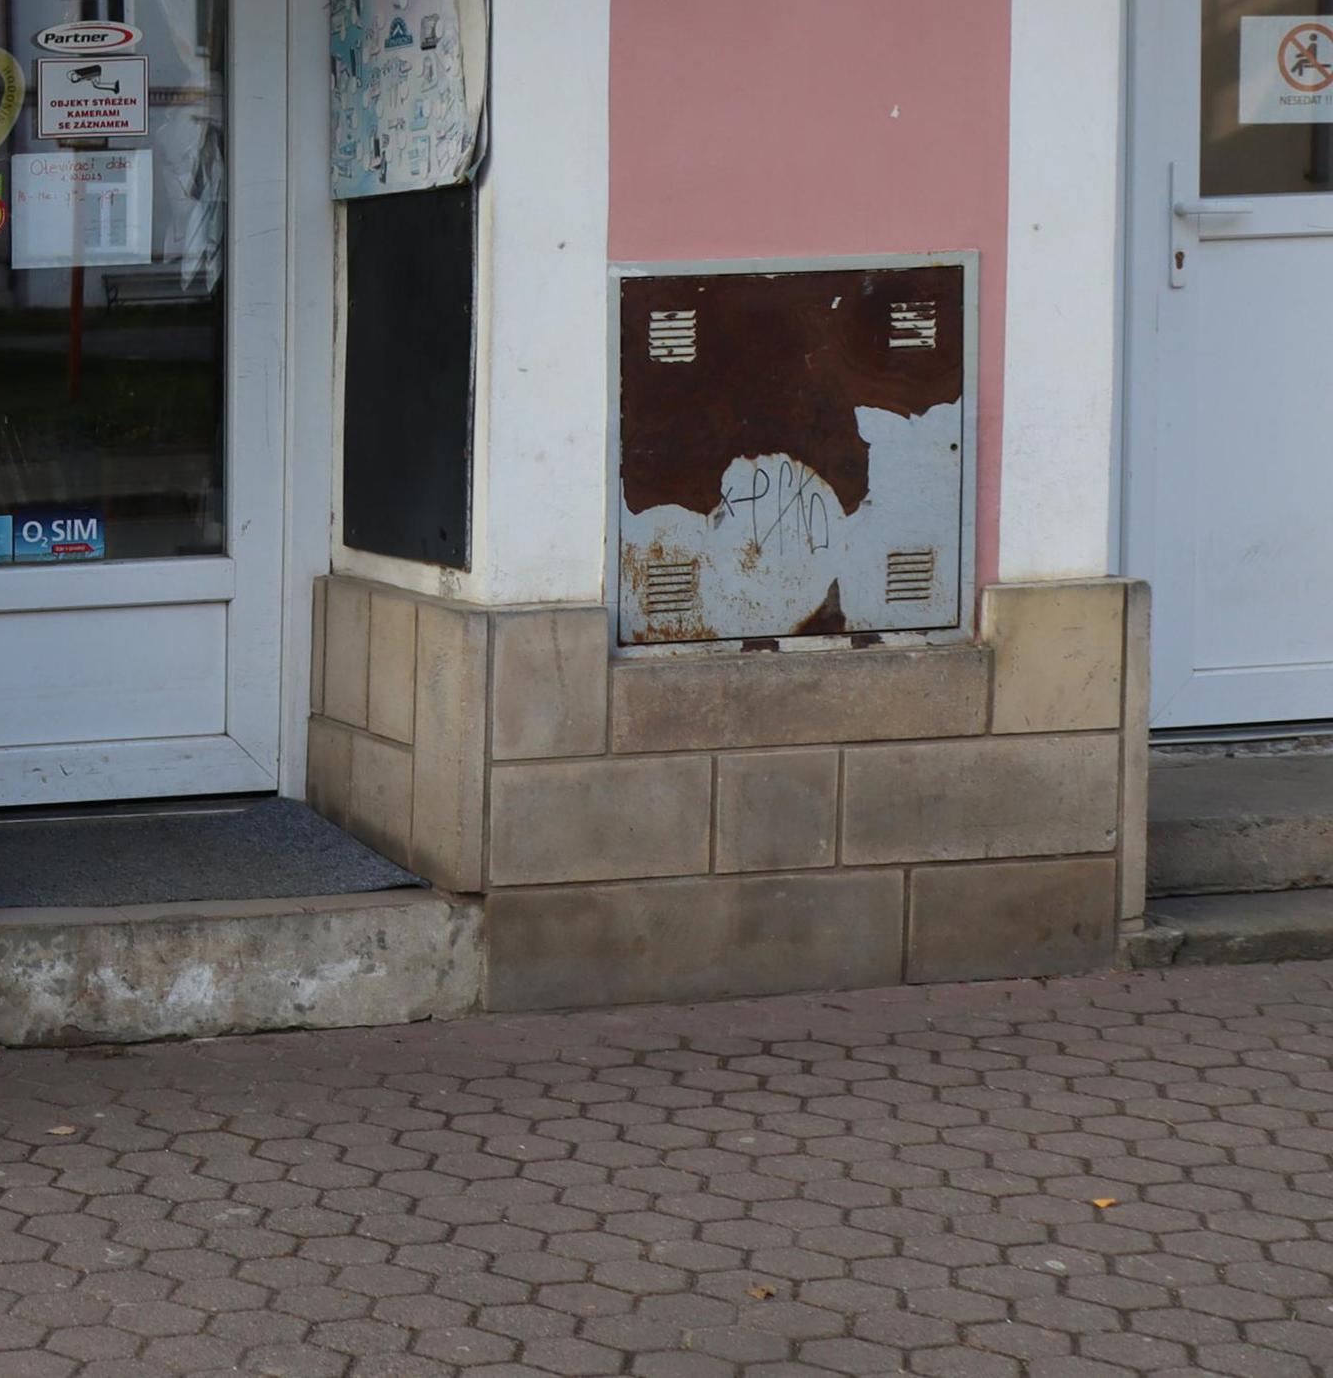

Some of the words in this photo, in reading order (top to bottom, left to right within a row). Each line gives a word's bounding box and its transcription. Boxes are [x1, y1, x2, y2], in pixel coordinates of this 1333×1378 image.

[44, 33, 109, 44] Partner
[50, 98, 88, 108] OBJEKT
[92, 97, 137, 107] STŘEŽEN
[1279, 96, 1322, 105] NESEDAT
[67, 109, 120, 119] KAMERAMI
[58, 121, 71, 130] SE
[73, 119, 129, 129] ZÁZNAMEM
[51, 518, 98, 542] SIM
